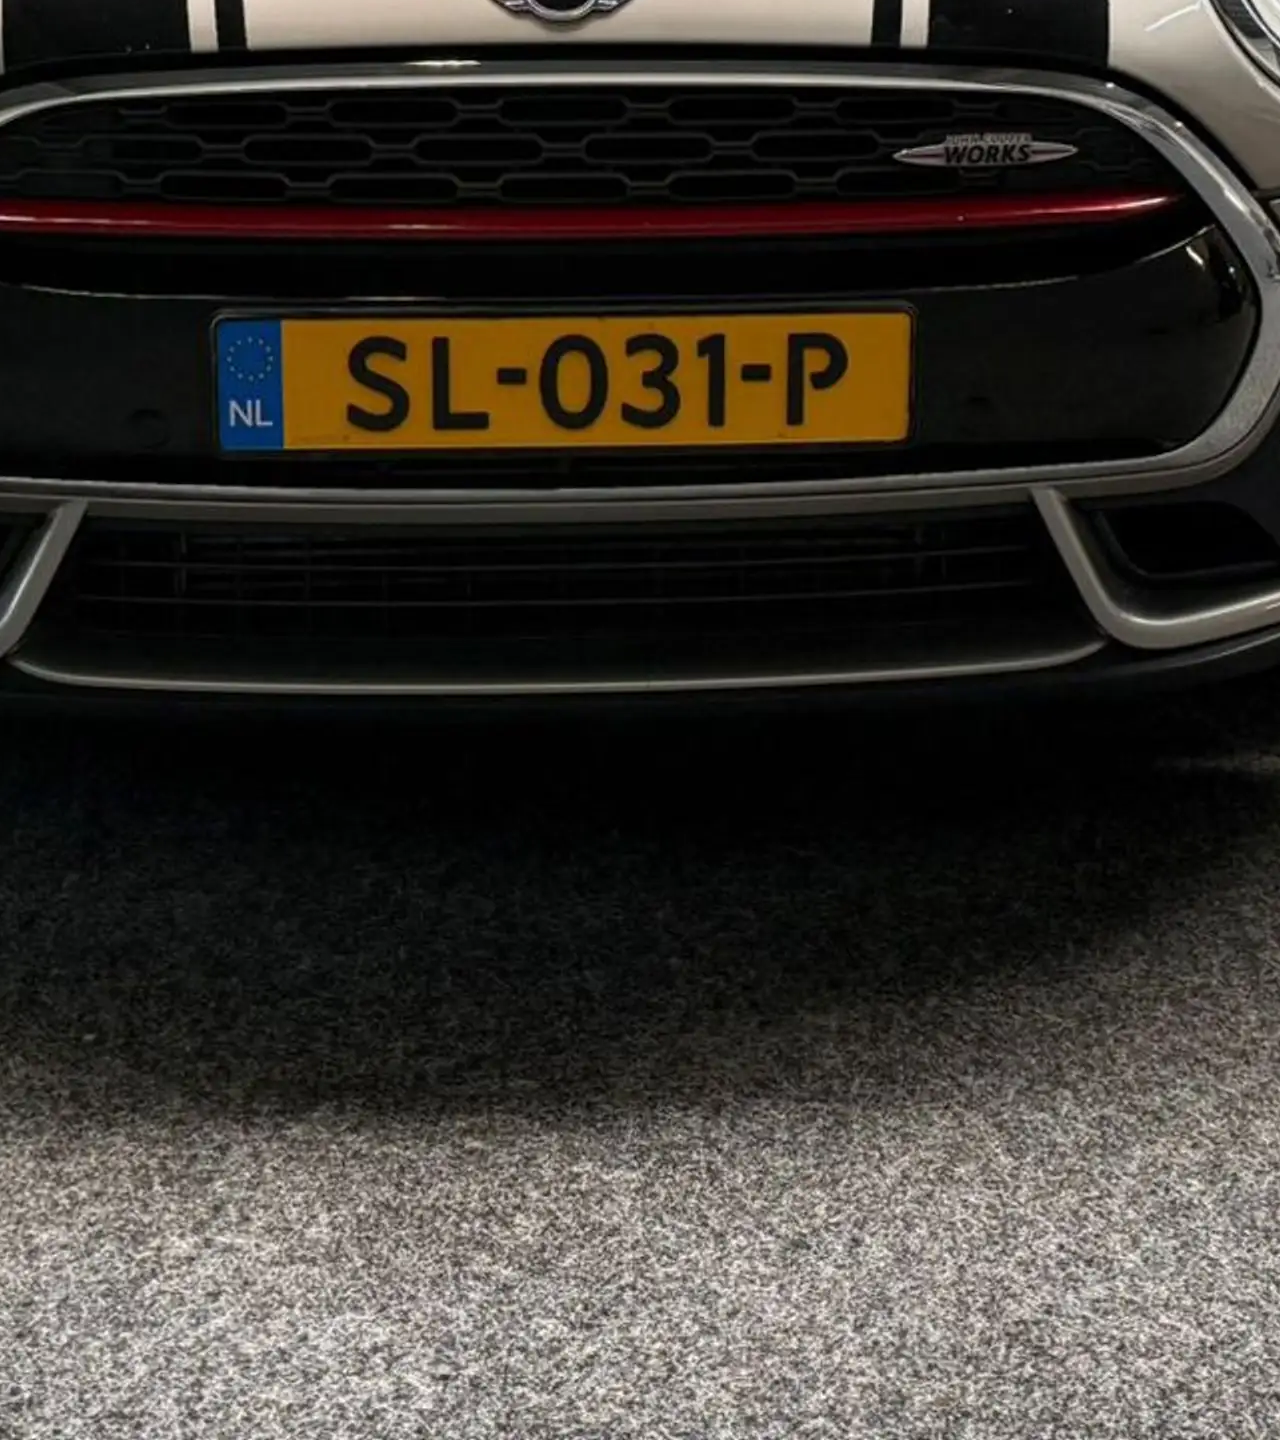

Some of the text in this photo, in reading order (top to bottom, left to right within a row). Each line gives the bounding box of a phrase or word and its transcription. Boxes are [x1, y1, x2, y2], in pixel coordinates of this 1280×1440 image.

[944, 144, 1032, 164] WORKS
[229, 332, 849, 433] NL SL-031-P
